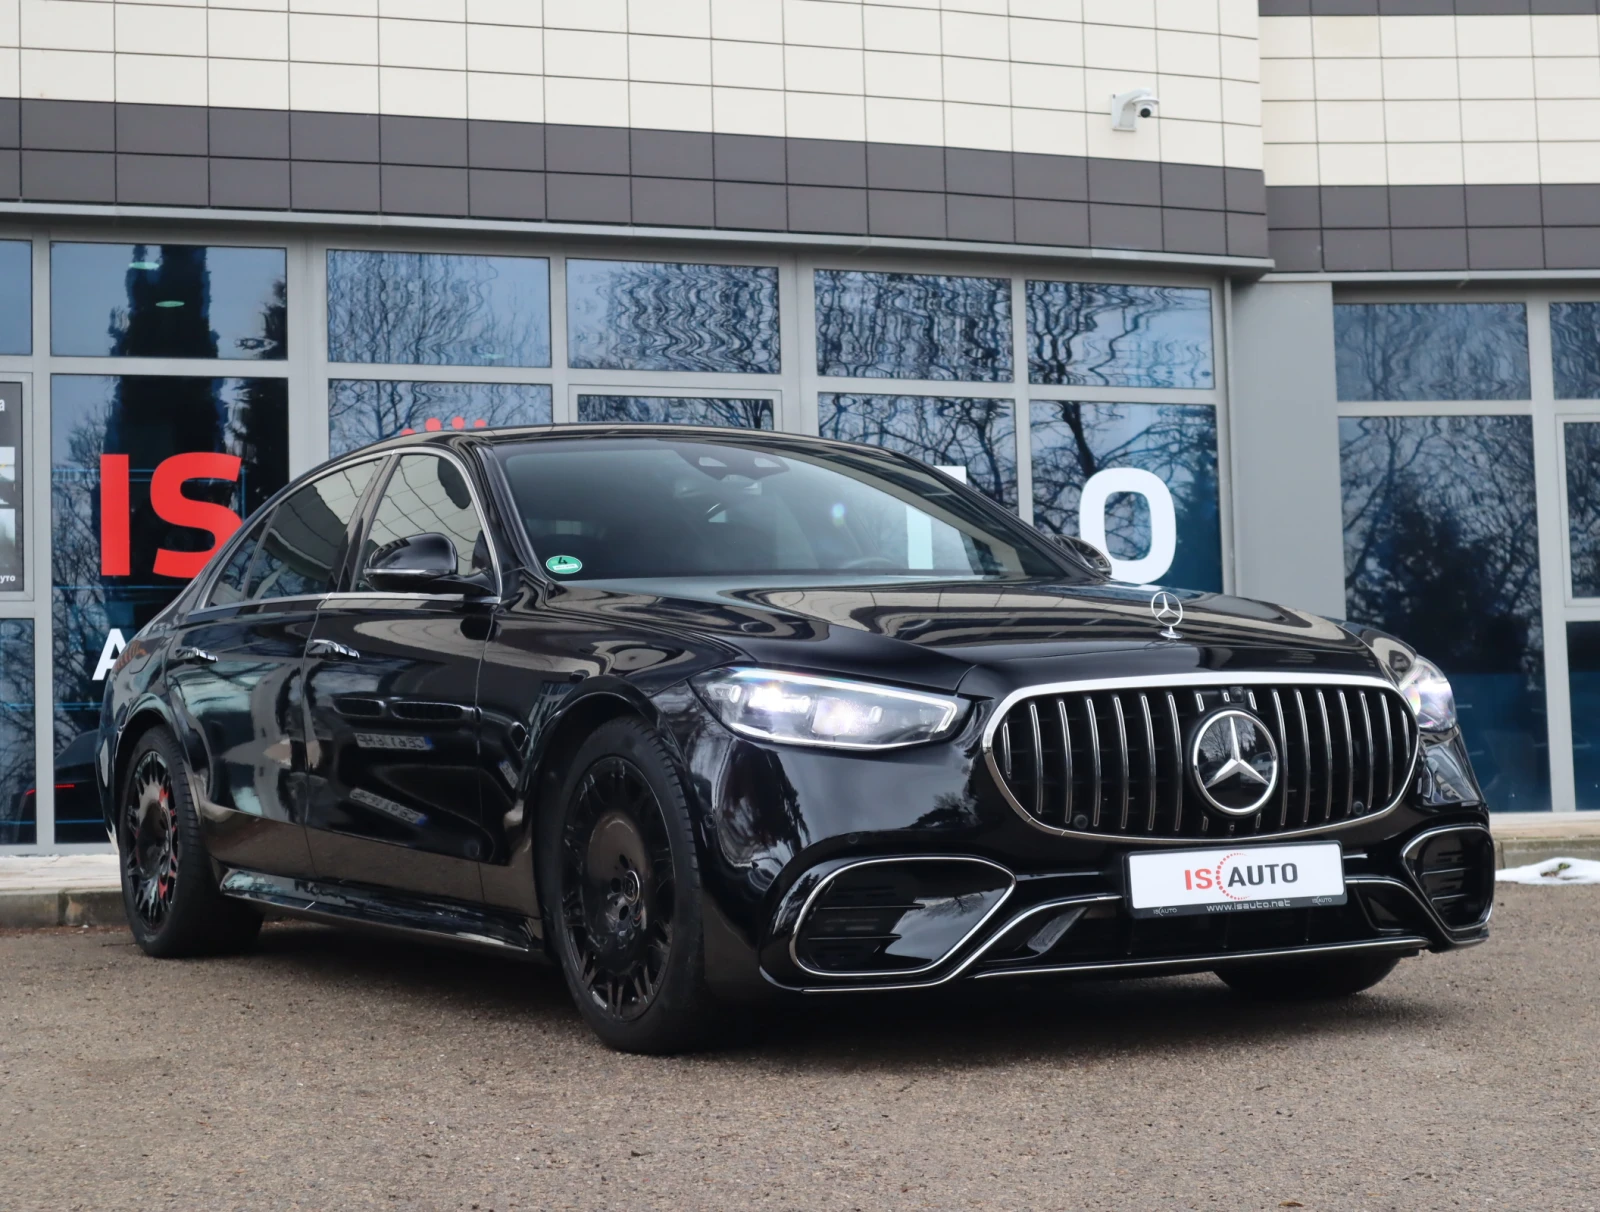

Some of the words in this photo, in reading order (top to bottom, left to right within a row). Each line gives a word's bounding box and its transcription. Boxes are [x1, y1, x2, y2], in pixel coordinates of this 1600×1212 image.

[100, 452, 243, 579] IS
[1184, 868, 1213, 890] IS
[1227, 862, 1298, 888] AUTO
[1206, 899, 1291, 912] www.isauto.net
